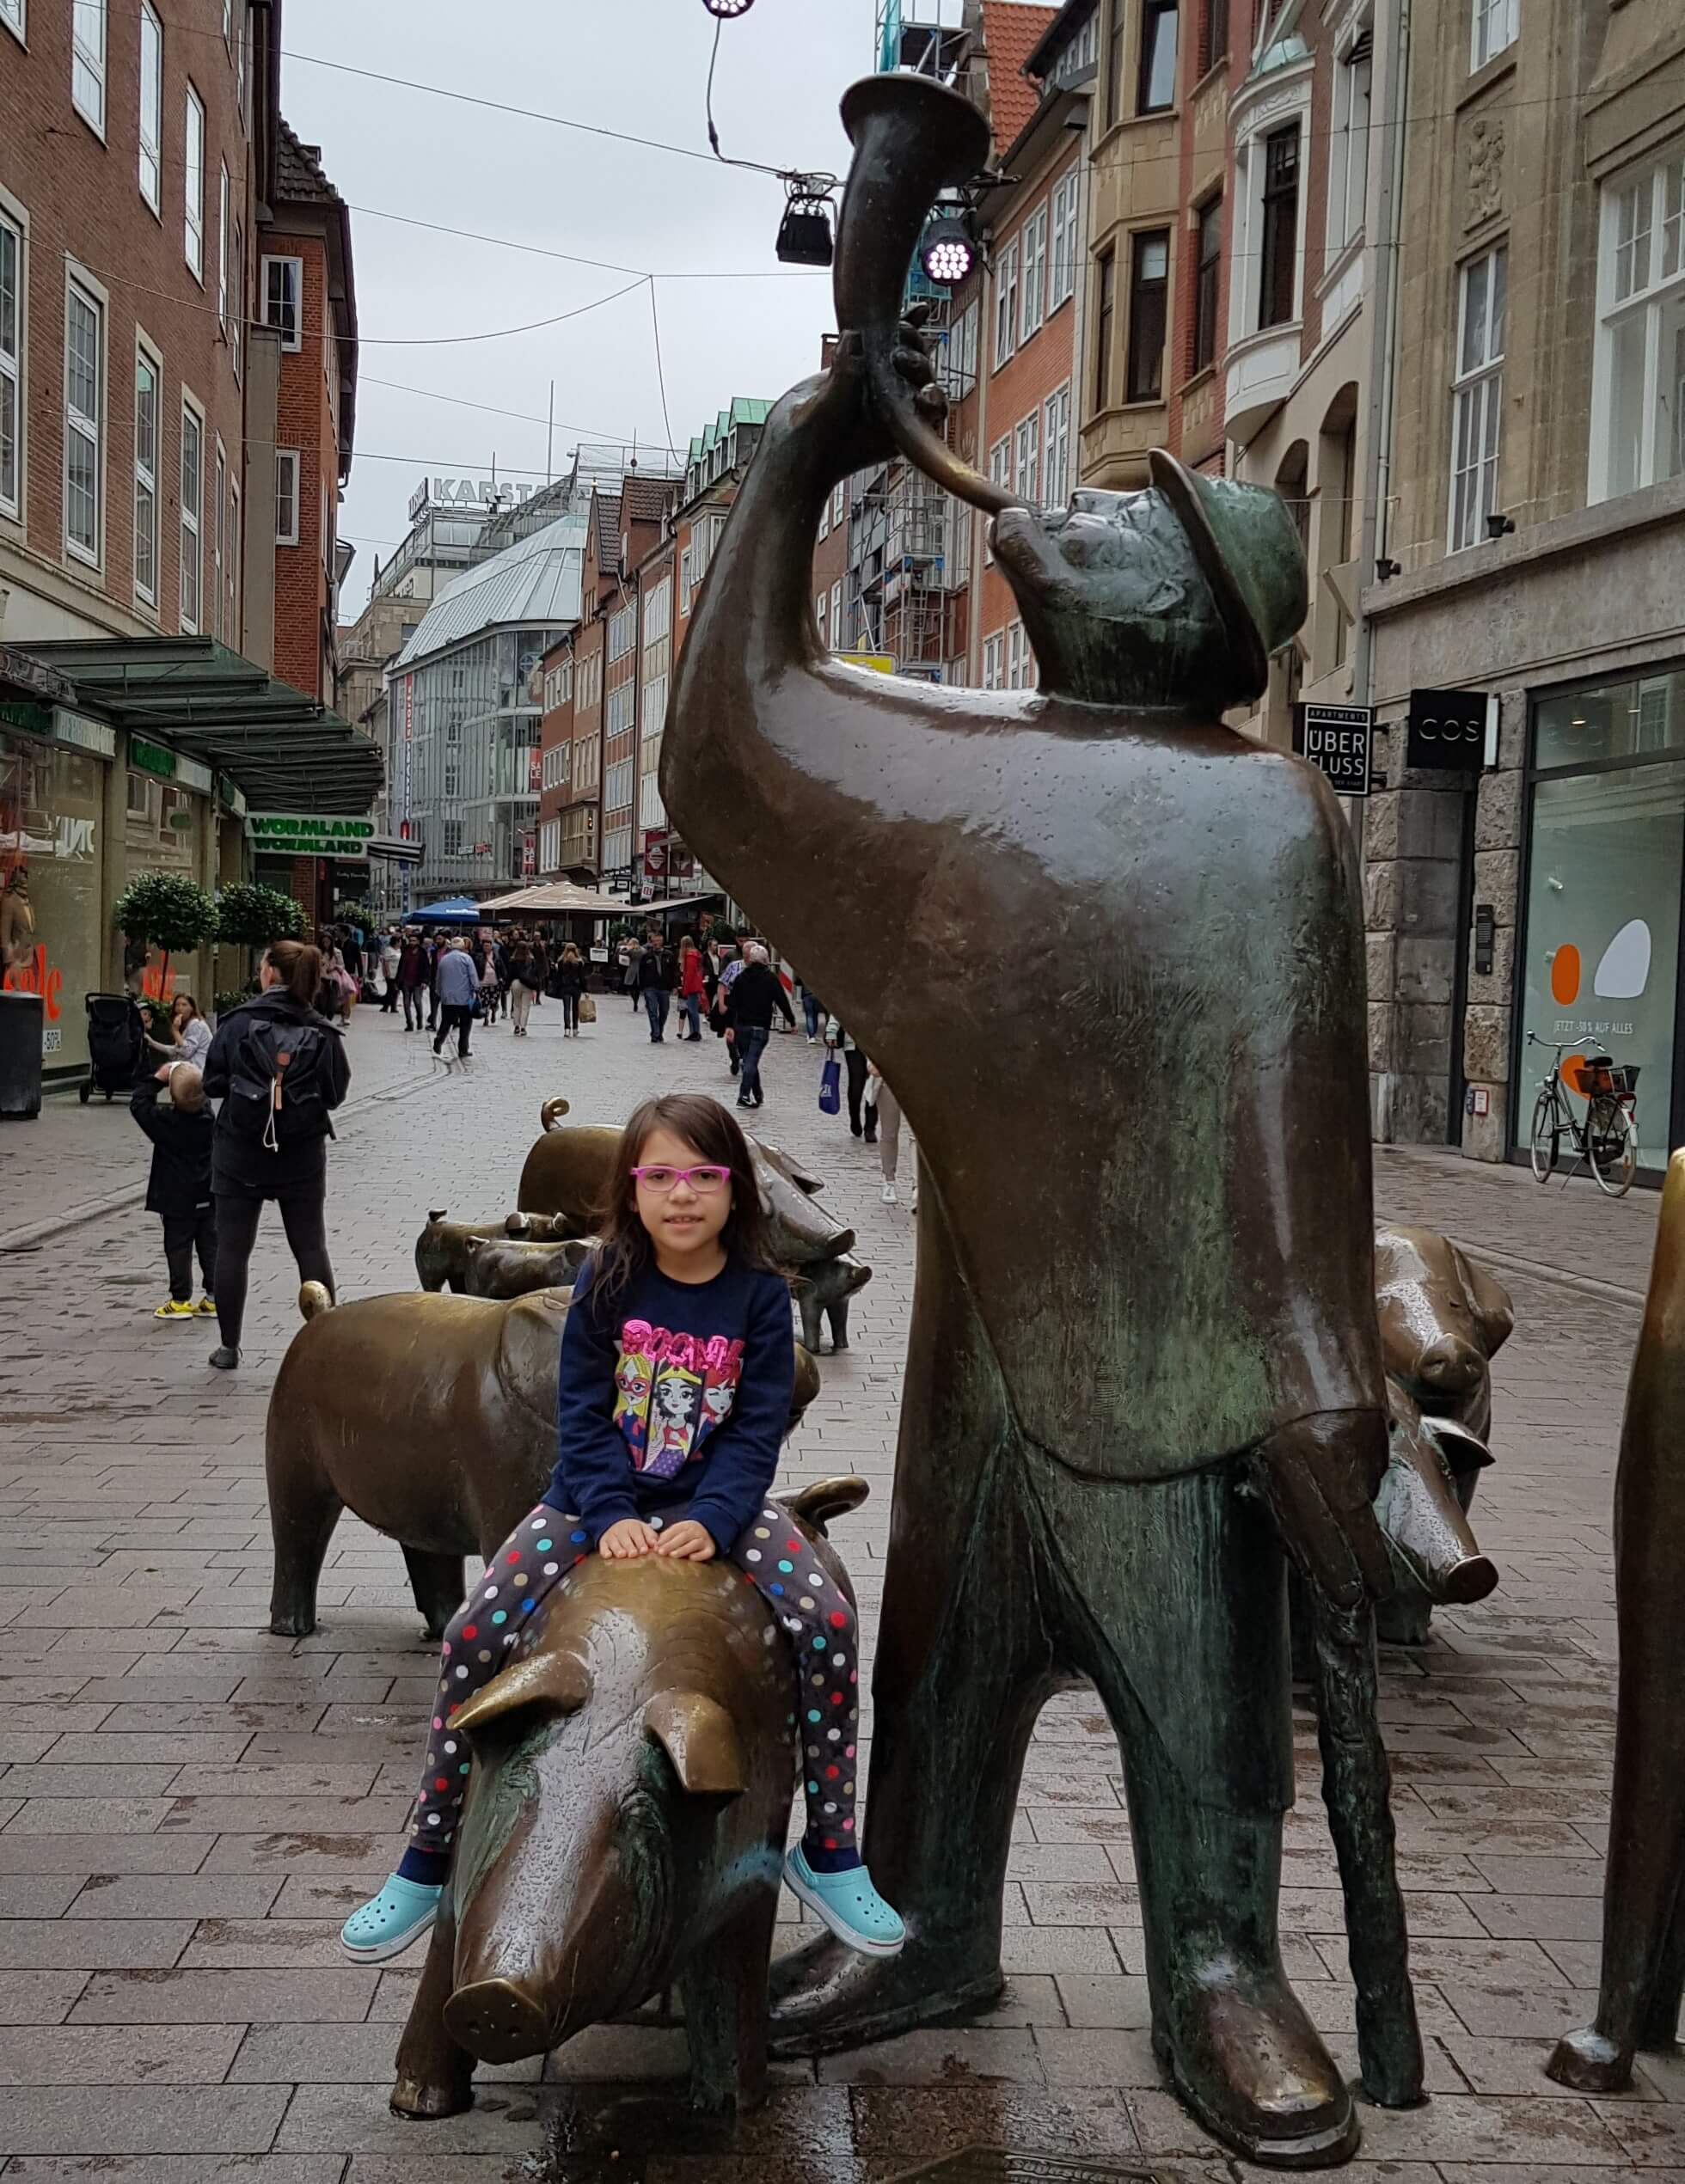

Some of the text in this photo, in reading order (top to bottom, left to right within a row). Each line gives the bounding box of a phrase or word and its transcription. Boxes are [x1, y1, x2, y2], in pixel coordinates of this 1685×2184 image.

[1309, 709, 1367, 721] APARTMENTS
[1419, 719, 1480, 742] COS
[1308, 730, 1365, 755] ÜBER
[251, 817, 375, 838] WORMLAND
[254, 837, 364, 854] WORMLAND
[1595, 1022, 1609, 1032] AUF
[1611, 1023, 1633, 1034] ALLES
